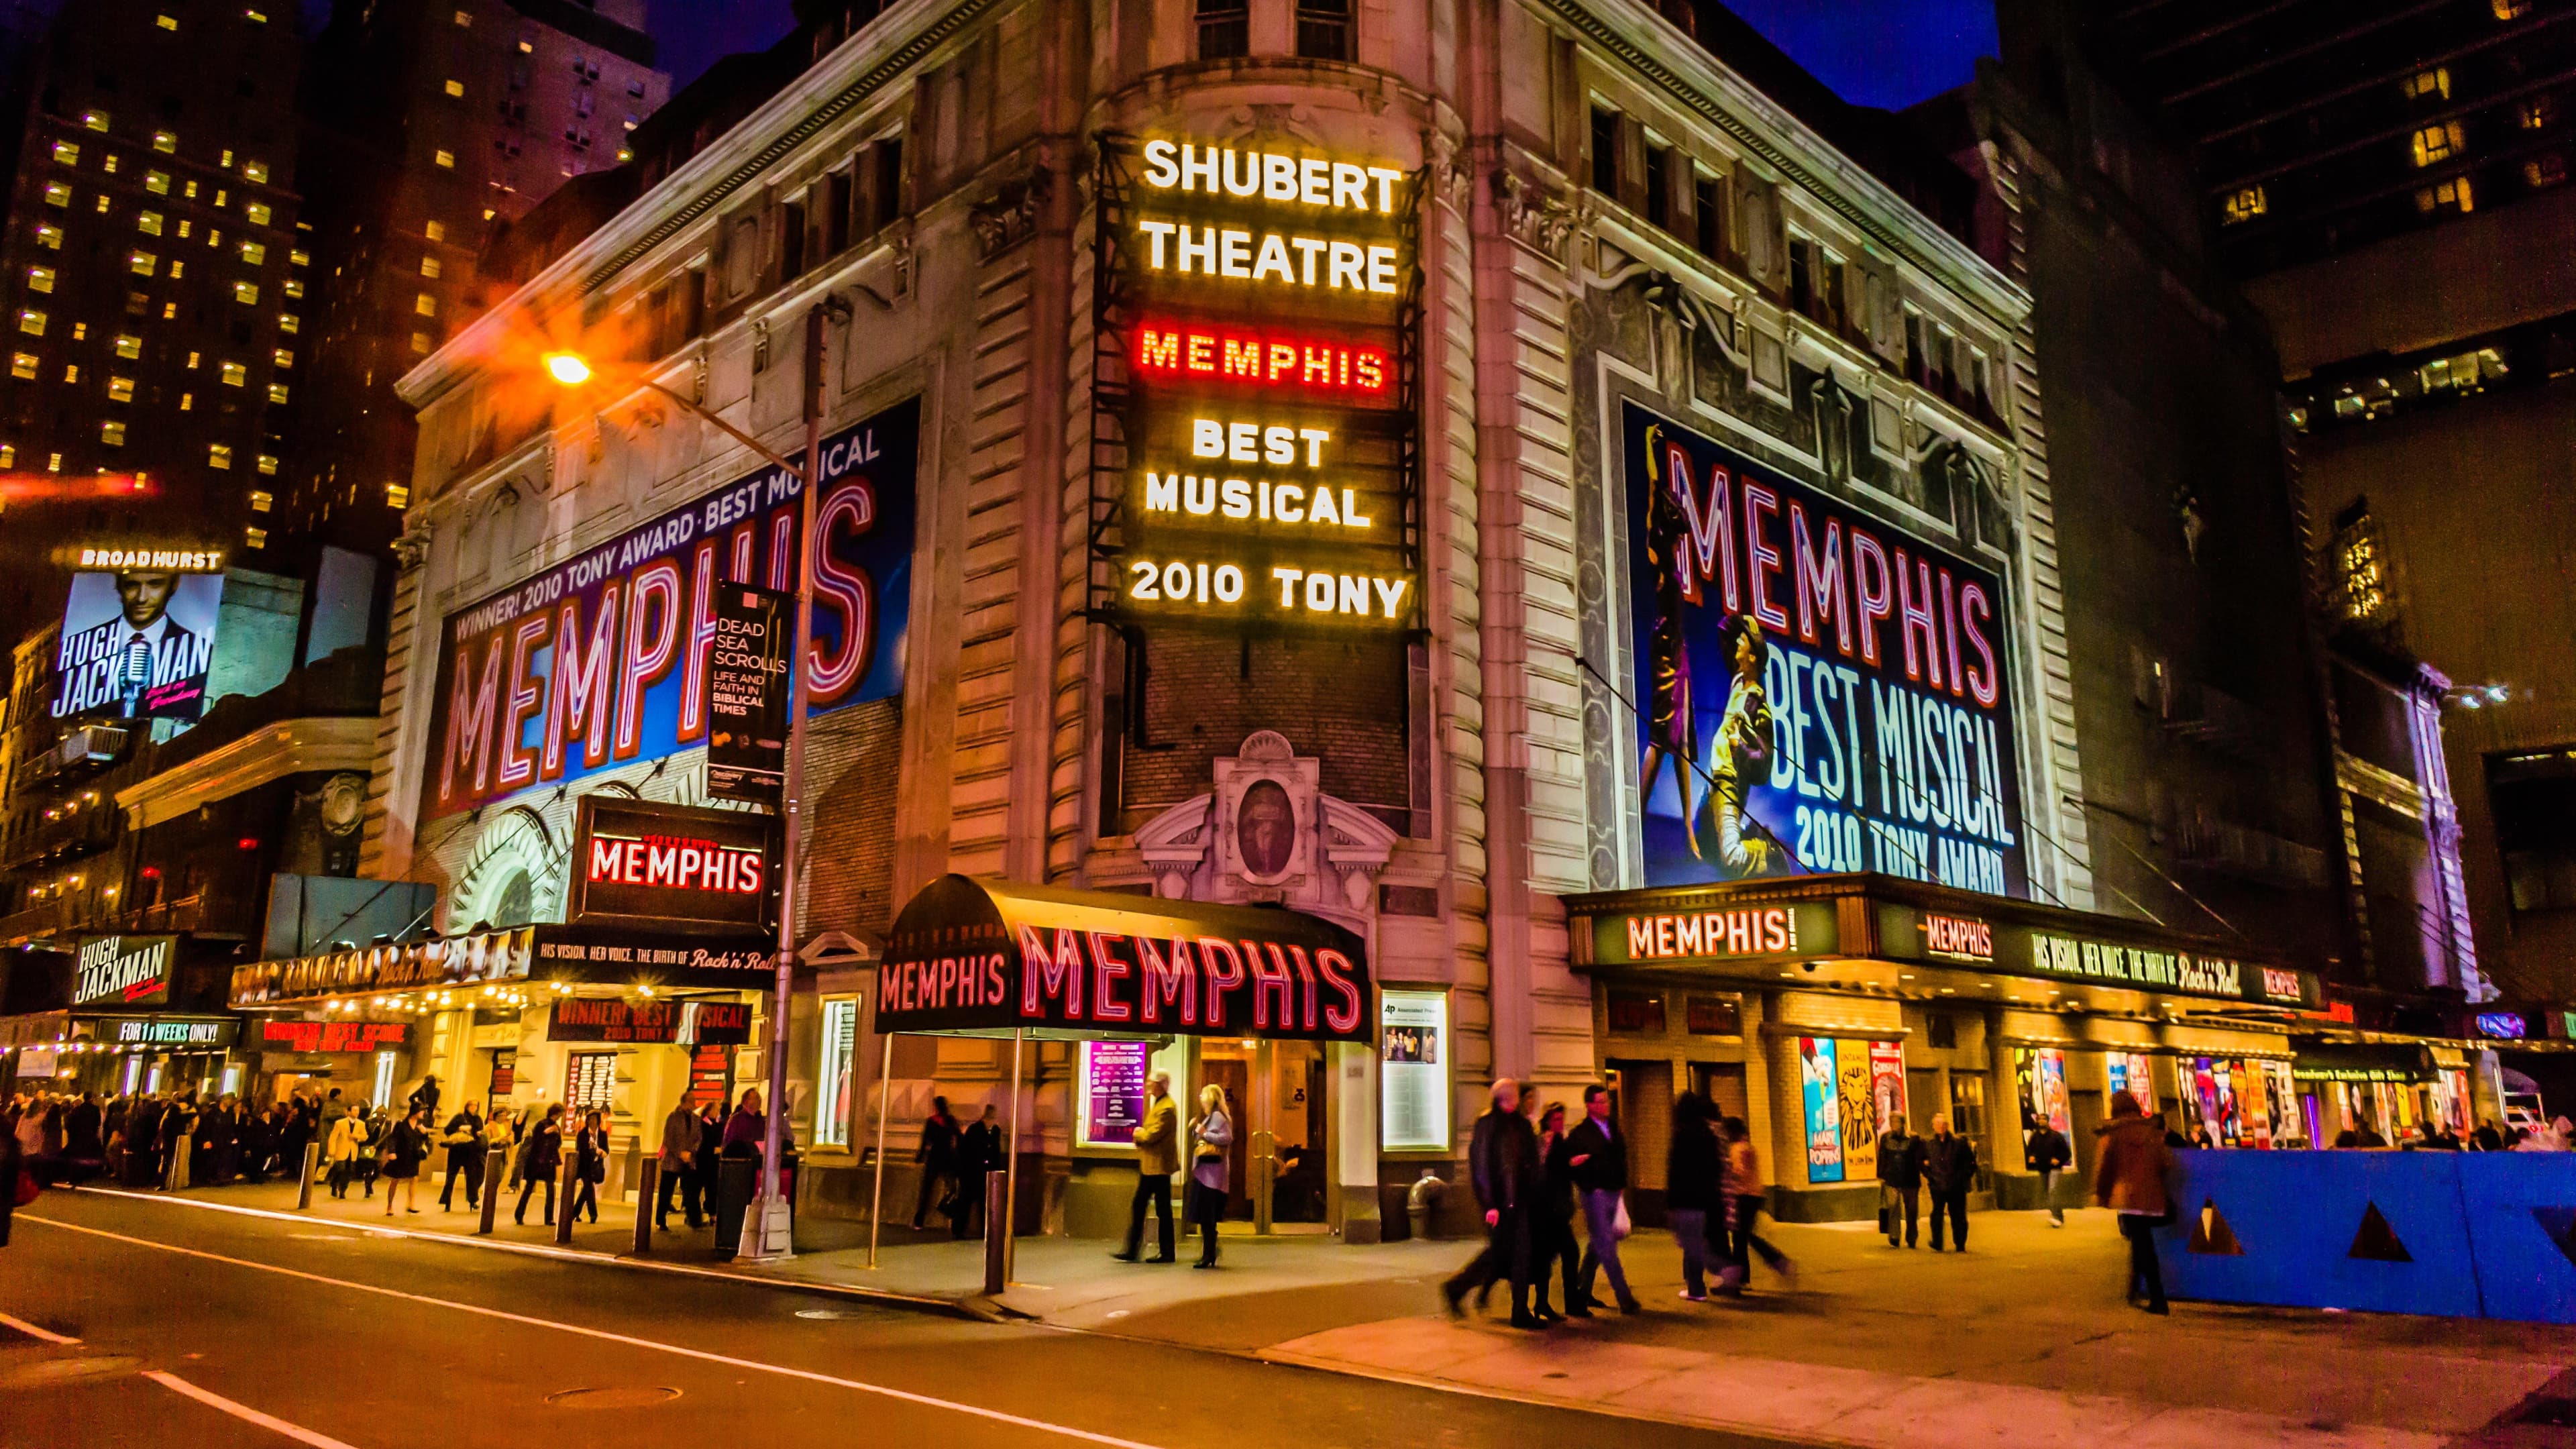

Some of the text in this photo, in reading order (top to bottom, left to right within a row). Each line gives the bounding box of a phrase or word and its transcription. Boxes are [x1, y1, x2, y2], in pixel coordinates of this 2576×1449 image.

[1143, 140, 1402, 213] SHUBERT
[1139, 220, 1397, 294] THEATRE
[1141, 329, 1385, 389] MEMPHIS
[1192, 419, 1330, 468] BEST
[1146, 472, 1371, 528] MUSICAL
[81, 549, 221, 569] BROADHURST
[457, 594, 521, 641] WINNER!
[523, 574, 562, 612] 2010
[568, 547, 617, 592] TONY
[705, 480, 762, 532] BEST
[767, 429, 880, 505] MUICAL
[1130, 561, 1407, 618] 2010 TONY
[1668, 447, 1996, 706] MEMPHIS
[58, 622, 122, 672] HUGH
[716, 634, 749, 651] SEA
[718, 617, 765, 637] DEAD
[714, 651, 787, 674] SCROLLS
[714, 671, 765, 686] LIFE AND
[712, 703, 747, 716] TIMES
[713, 682, 759, 696] FAITH IN
[713, 692, 764, 708] BIBLICAL
[1764, 641, 2015, 846] BEST MUSICAL
[590, 839, 762, 894] MEMPHIS
[1796, 805, 2006, 897] 2010 TONY AWARD
[77, 935, 121, 973] HUGH
[540, 943, 555, 958] HIS
[557, 945, 586, 960] VISION.
[590, 946, 607, 961] HER
[608, 947, 634, 963] VOICE.
[637, 948, 652, 963] THE
[653, 949, 677, 965] BIRTH
[678, 951, 689, 965] OF
[689, 948, 729, 968] Rock
[1926, 914, 1992, 957] MEMPHIS
[2031, 933, 2050, 969] HIS
[2082, 942, 2101, 976] HER
[2127, 949, 2145, 981] THE
[2143, 951, 2167, 985] BIRTH
[2166, 955, 2177, 985] OF
[74, 942, 166, 1004] JACKMAN
[880, 952, 1005, 1013] MEMPHIS
[1014, 920, 1362, 1034] MEMPHIS
[2262, 967, 2301, 998] MEMPHIS
[119, 1022, 142, 1041] FOR
[155, 1023, 189, 1042] WEEKS
[189, 1024, 219, 1042] ONLY!
[558, 1001, 627, 1026] WINNER!
[633, 1004, 674, 1026] BEST
[1384, 1004, 1395, 1015] AP
[565, 1056, 580, 1134] MEMPHIS
